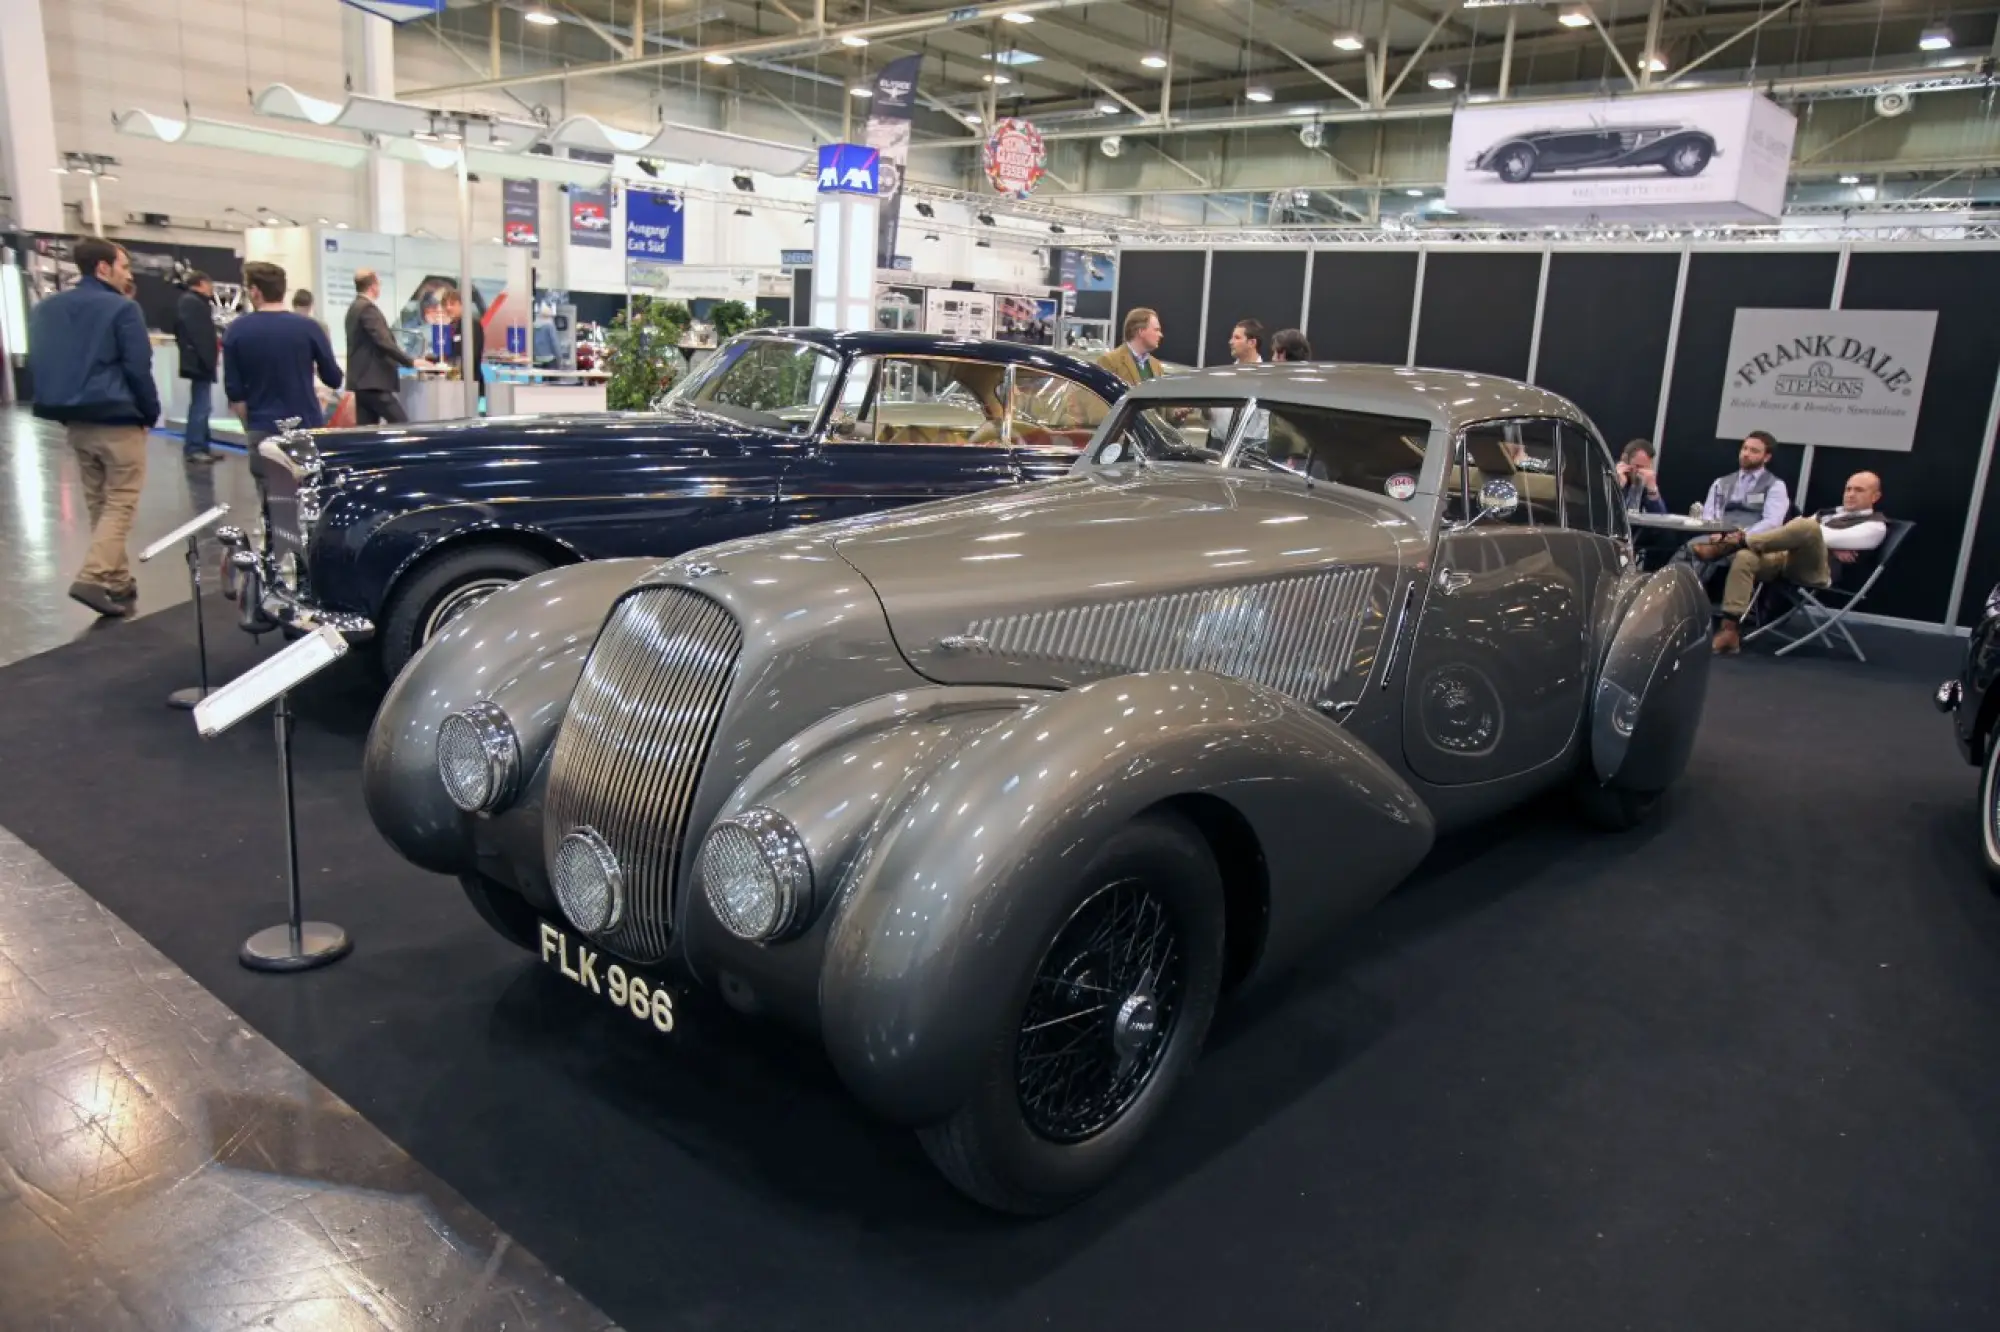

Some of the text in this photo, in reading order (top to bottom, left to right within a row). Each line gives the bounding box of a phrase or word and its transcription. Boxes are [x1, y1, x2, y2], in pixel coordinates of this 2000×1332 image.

[627, 238, 666, 254] Exit Süd
[1737, 334, 1913, 393] FRANK DALE
[1774, 378, 1864, 395] STEPSONS
[1804, 402, 1843, 415] Bentley
[1847, 404, 1907, 417] Specialists
[541, 923, 674, 1033] FLK 966
